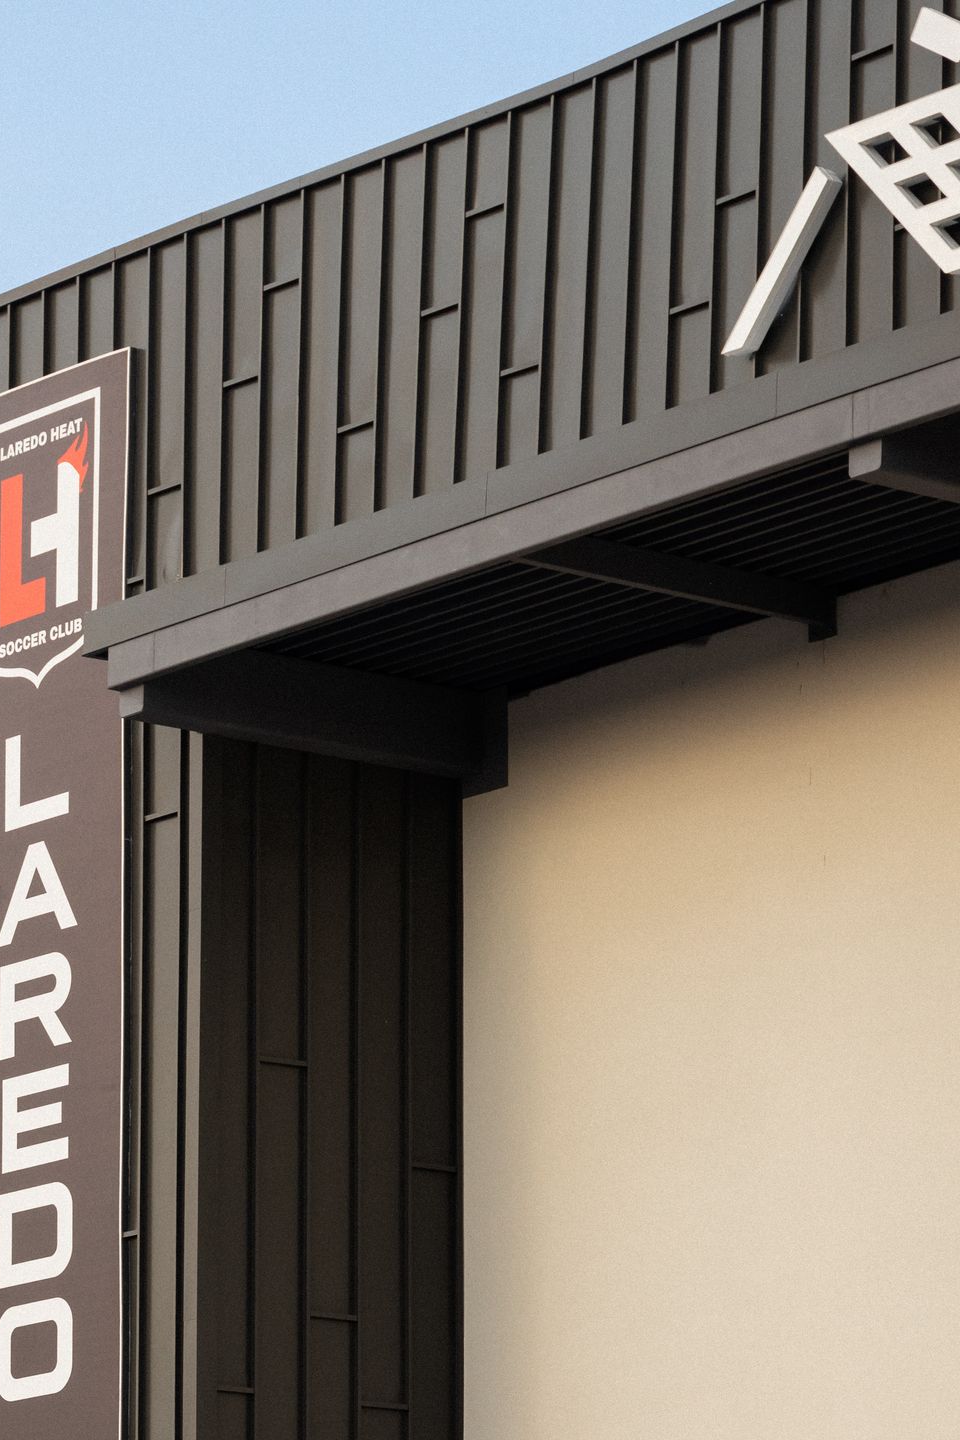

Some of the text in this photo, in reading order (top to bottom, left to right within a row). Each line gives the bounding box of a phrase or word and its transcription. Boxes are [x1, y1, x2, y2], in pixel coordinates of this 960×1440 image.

[0, 418, 82, 461] LAREDO HEAT
[49, 618, 82, 641] CLUB
